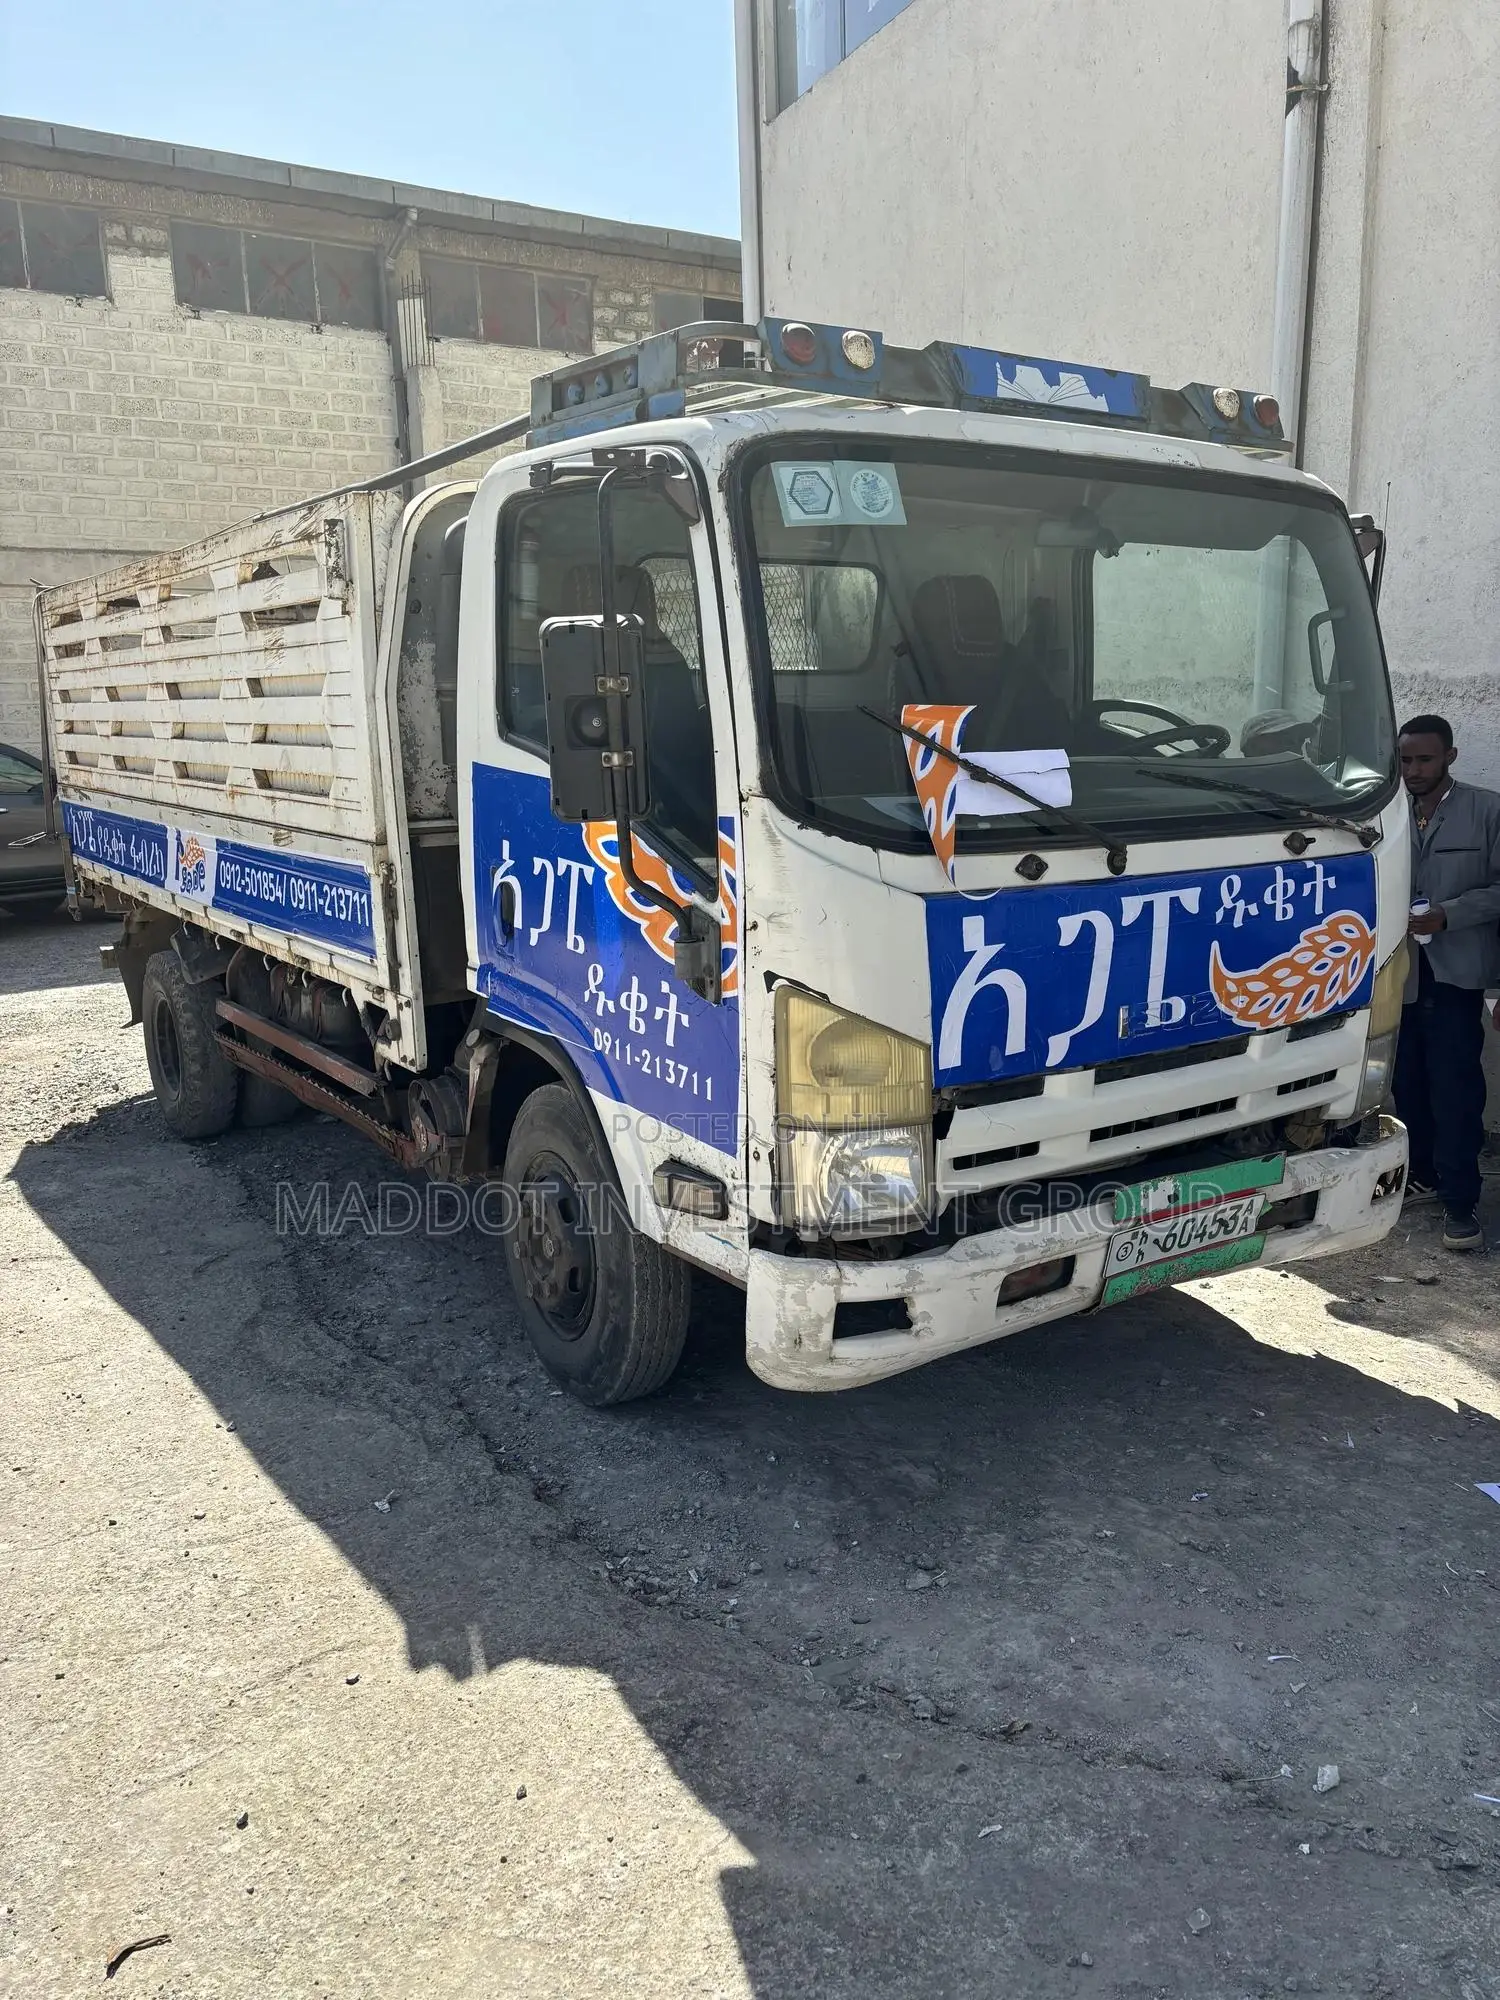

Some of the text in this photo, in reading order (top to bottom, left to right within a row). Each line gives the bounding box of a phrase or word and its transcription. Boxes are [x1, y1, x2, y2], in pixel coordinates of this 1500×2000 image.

[289, 877, 370, 927] 0911-213711
[491, 839, 595, 955] አጋፔ
[1215, 860, 1337, 929] ዱቄት
[584, 963, 690, 1047] ዱቄት
[938, 886, 1202, 1071] አጋፔ
[593, 1027, 712, 1101] 0911-213711
